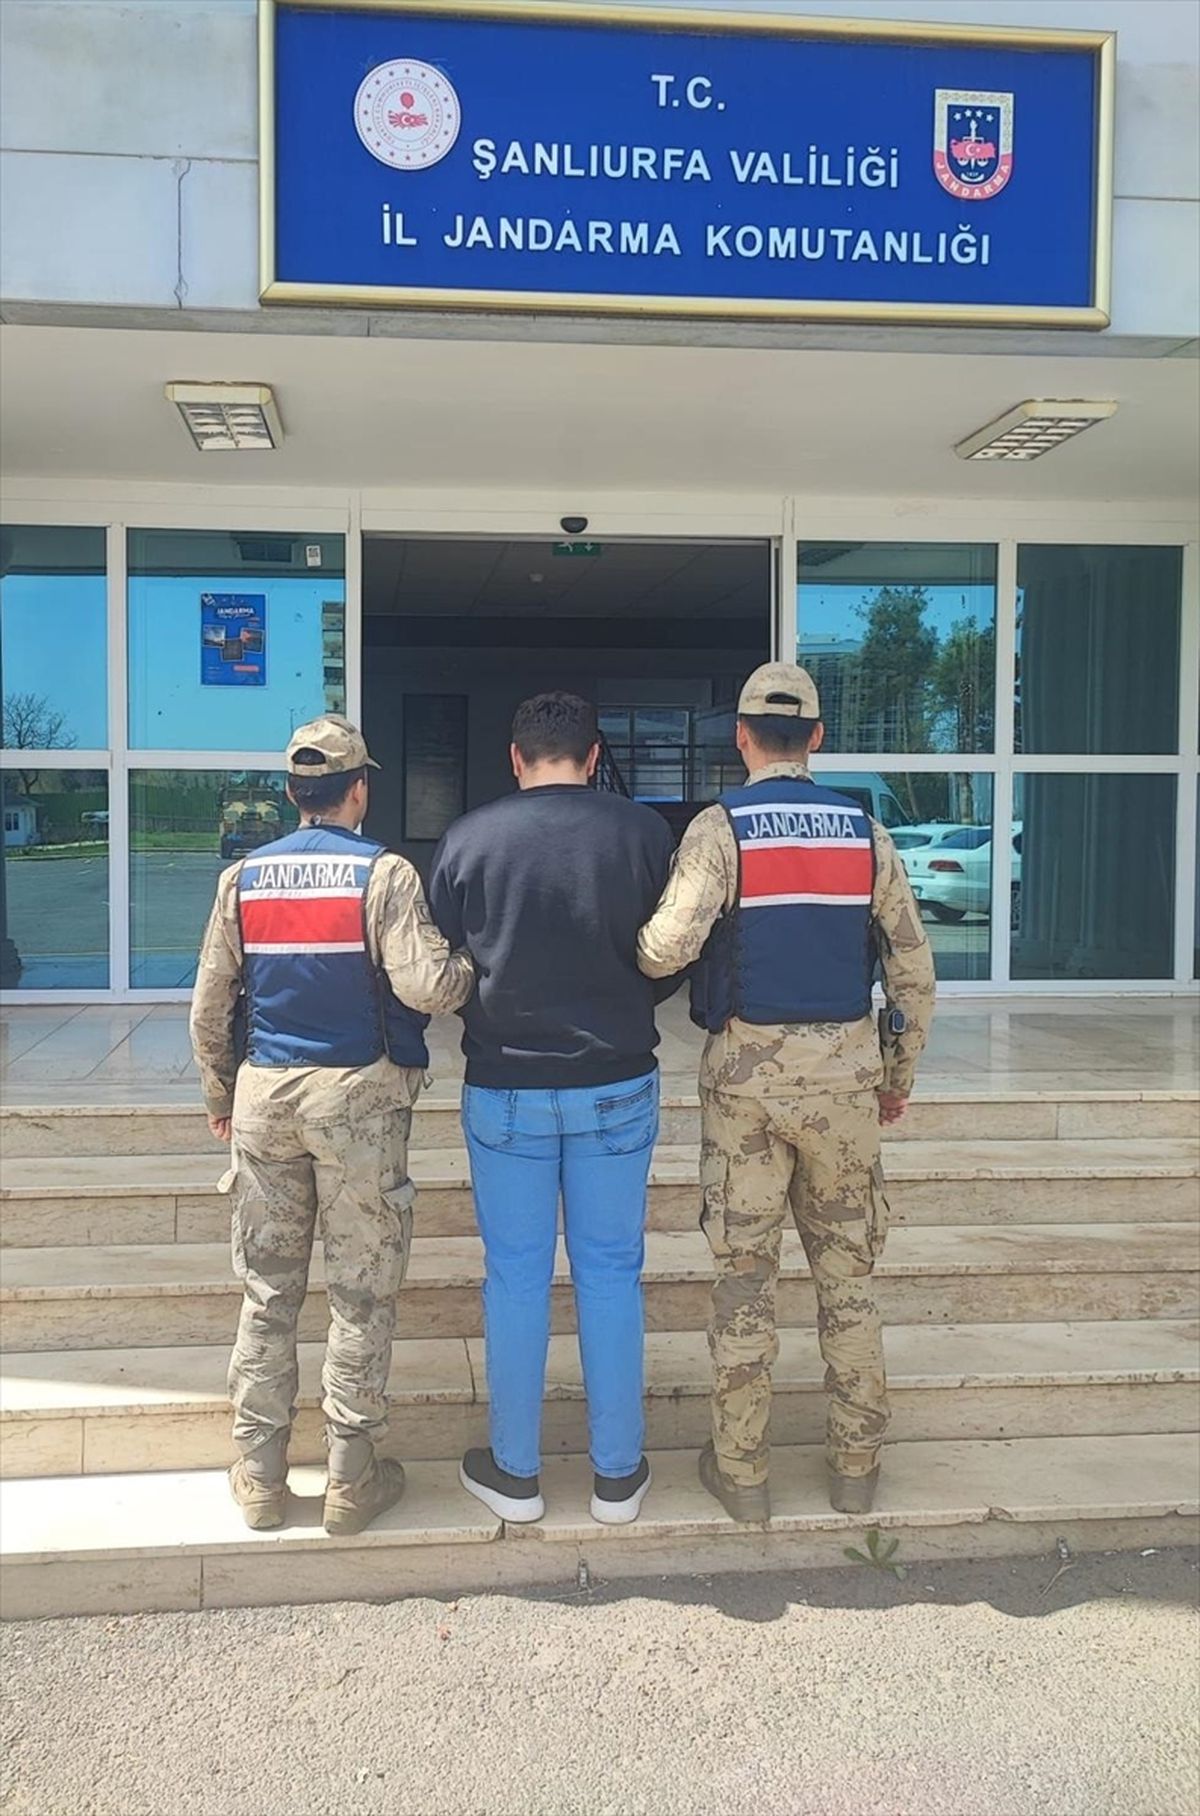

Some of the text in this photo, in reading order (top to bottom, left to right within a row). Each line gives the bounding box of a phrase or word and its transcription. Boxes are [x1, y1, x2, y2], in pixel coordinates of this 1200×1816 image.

[651, 74, 725, 110] T.C.
[473, 139, 898, 187] ŞANLIURFA VALİLİĞİ
[936, 162, 1010, 198] JANDARMA
[383, 203, 989, 264] İL JANDARMA KOMUTANLIĞI
[747, 812, 856, 838] JANDARMA
[252, 863, 356, 889] JANDARMA
